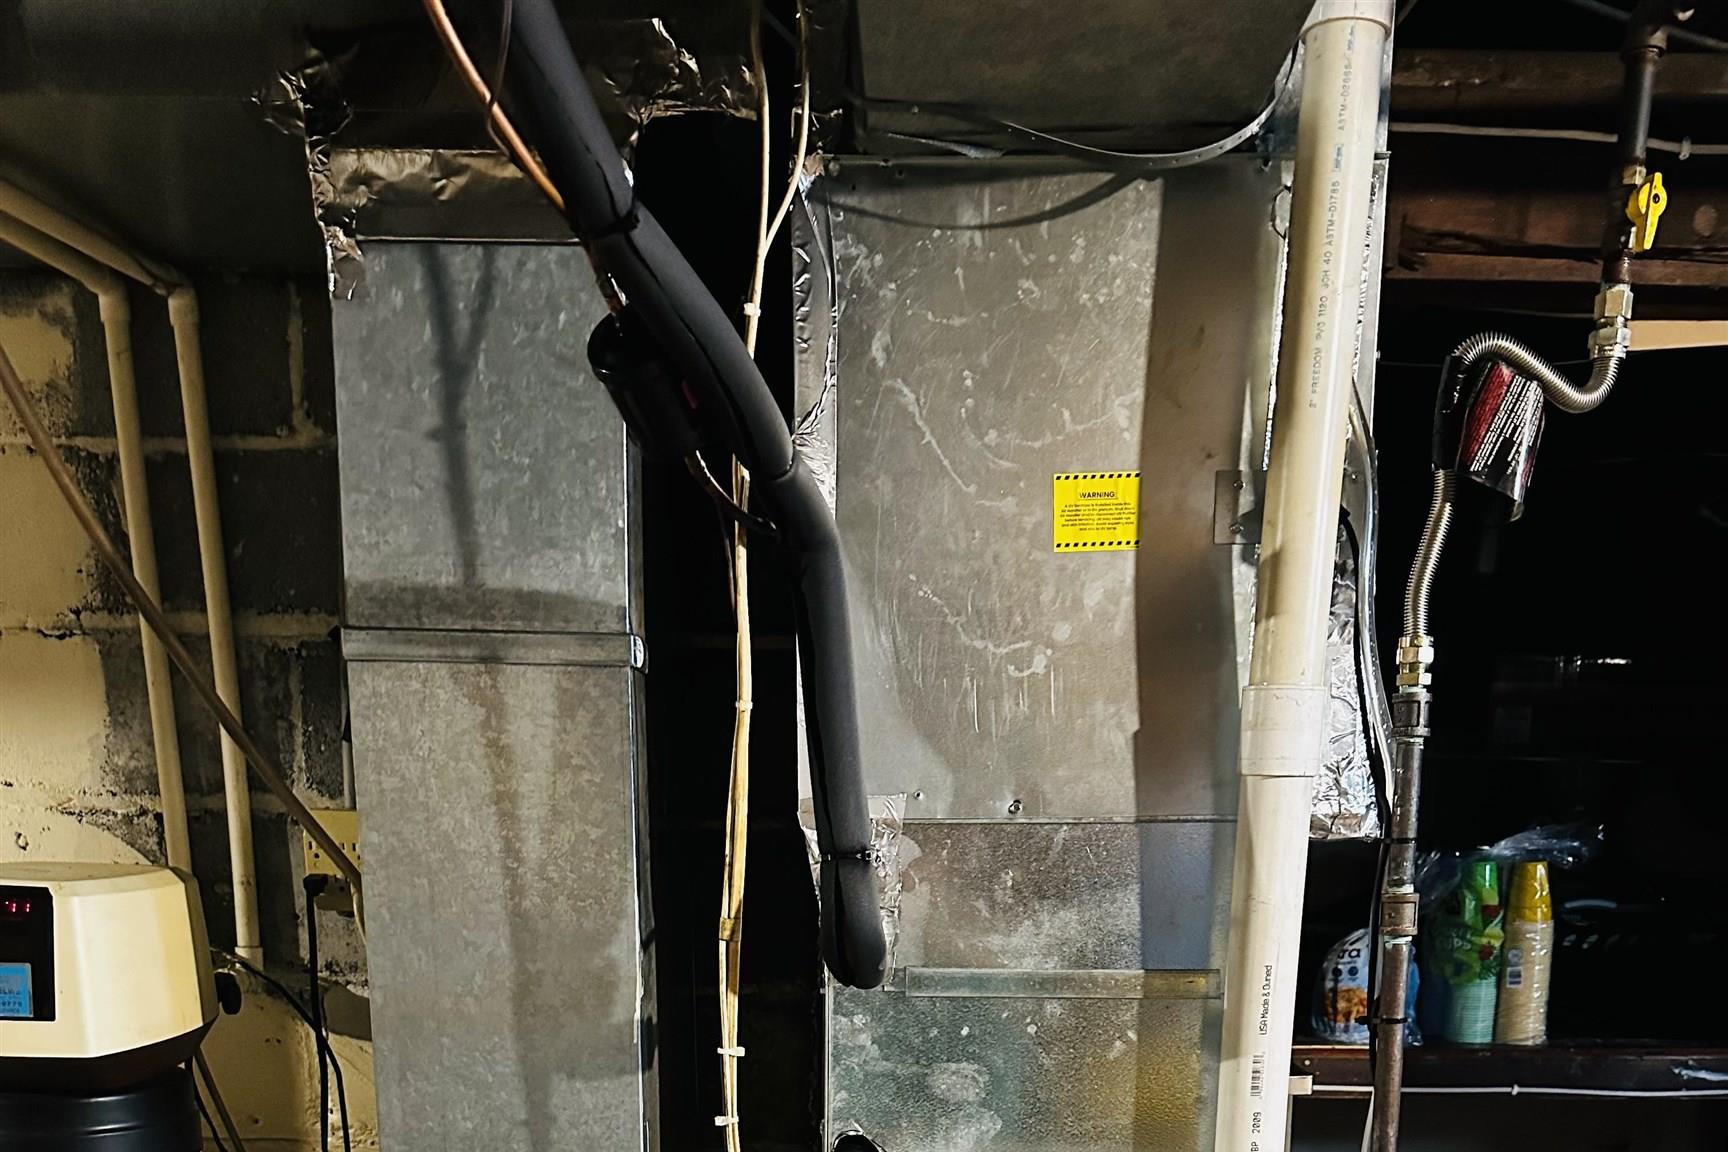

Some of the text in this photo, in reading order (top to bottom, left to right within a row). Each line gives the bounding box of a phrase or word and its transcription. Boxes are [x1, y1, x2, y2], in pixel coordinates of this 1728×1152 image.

[1323, 251, 1333, 265] 40
[1318, 296, 1329, 317] 1120
[1311, 347, 1322, 394] FREEDOM
[1260, 999, 1270, 1019] Made
[1258, 1020, 1268, 1036] USA
[1251, 1111, 1262, 1134] 2009
